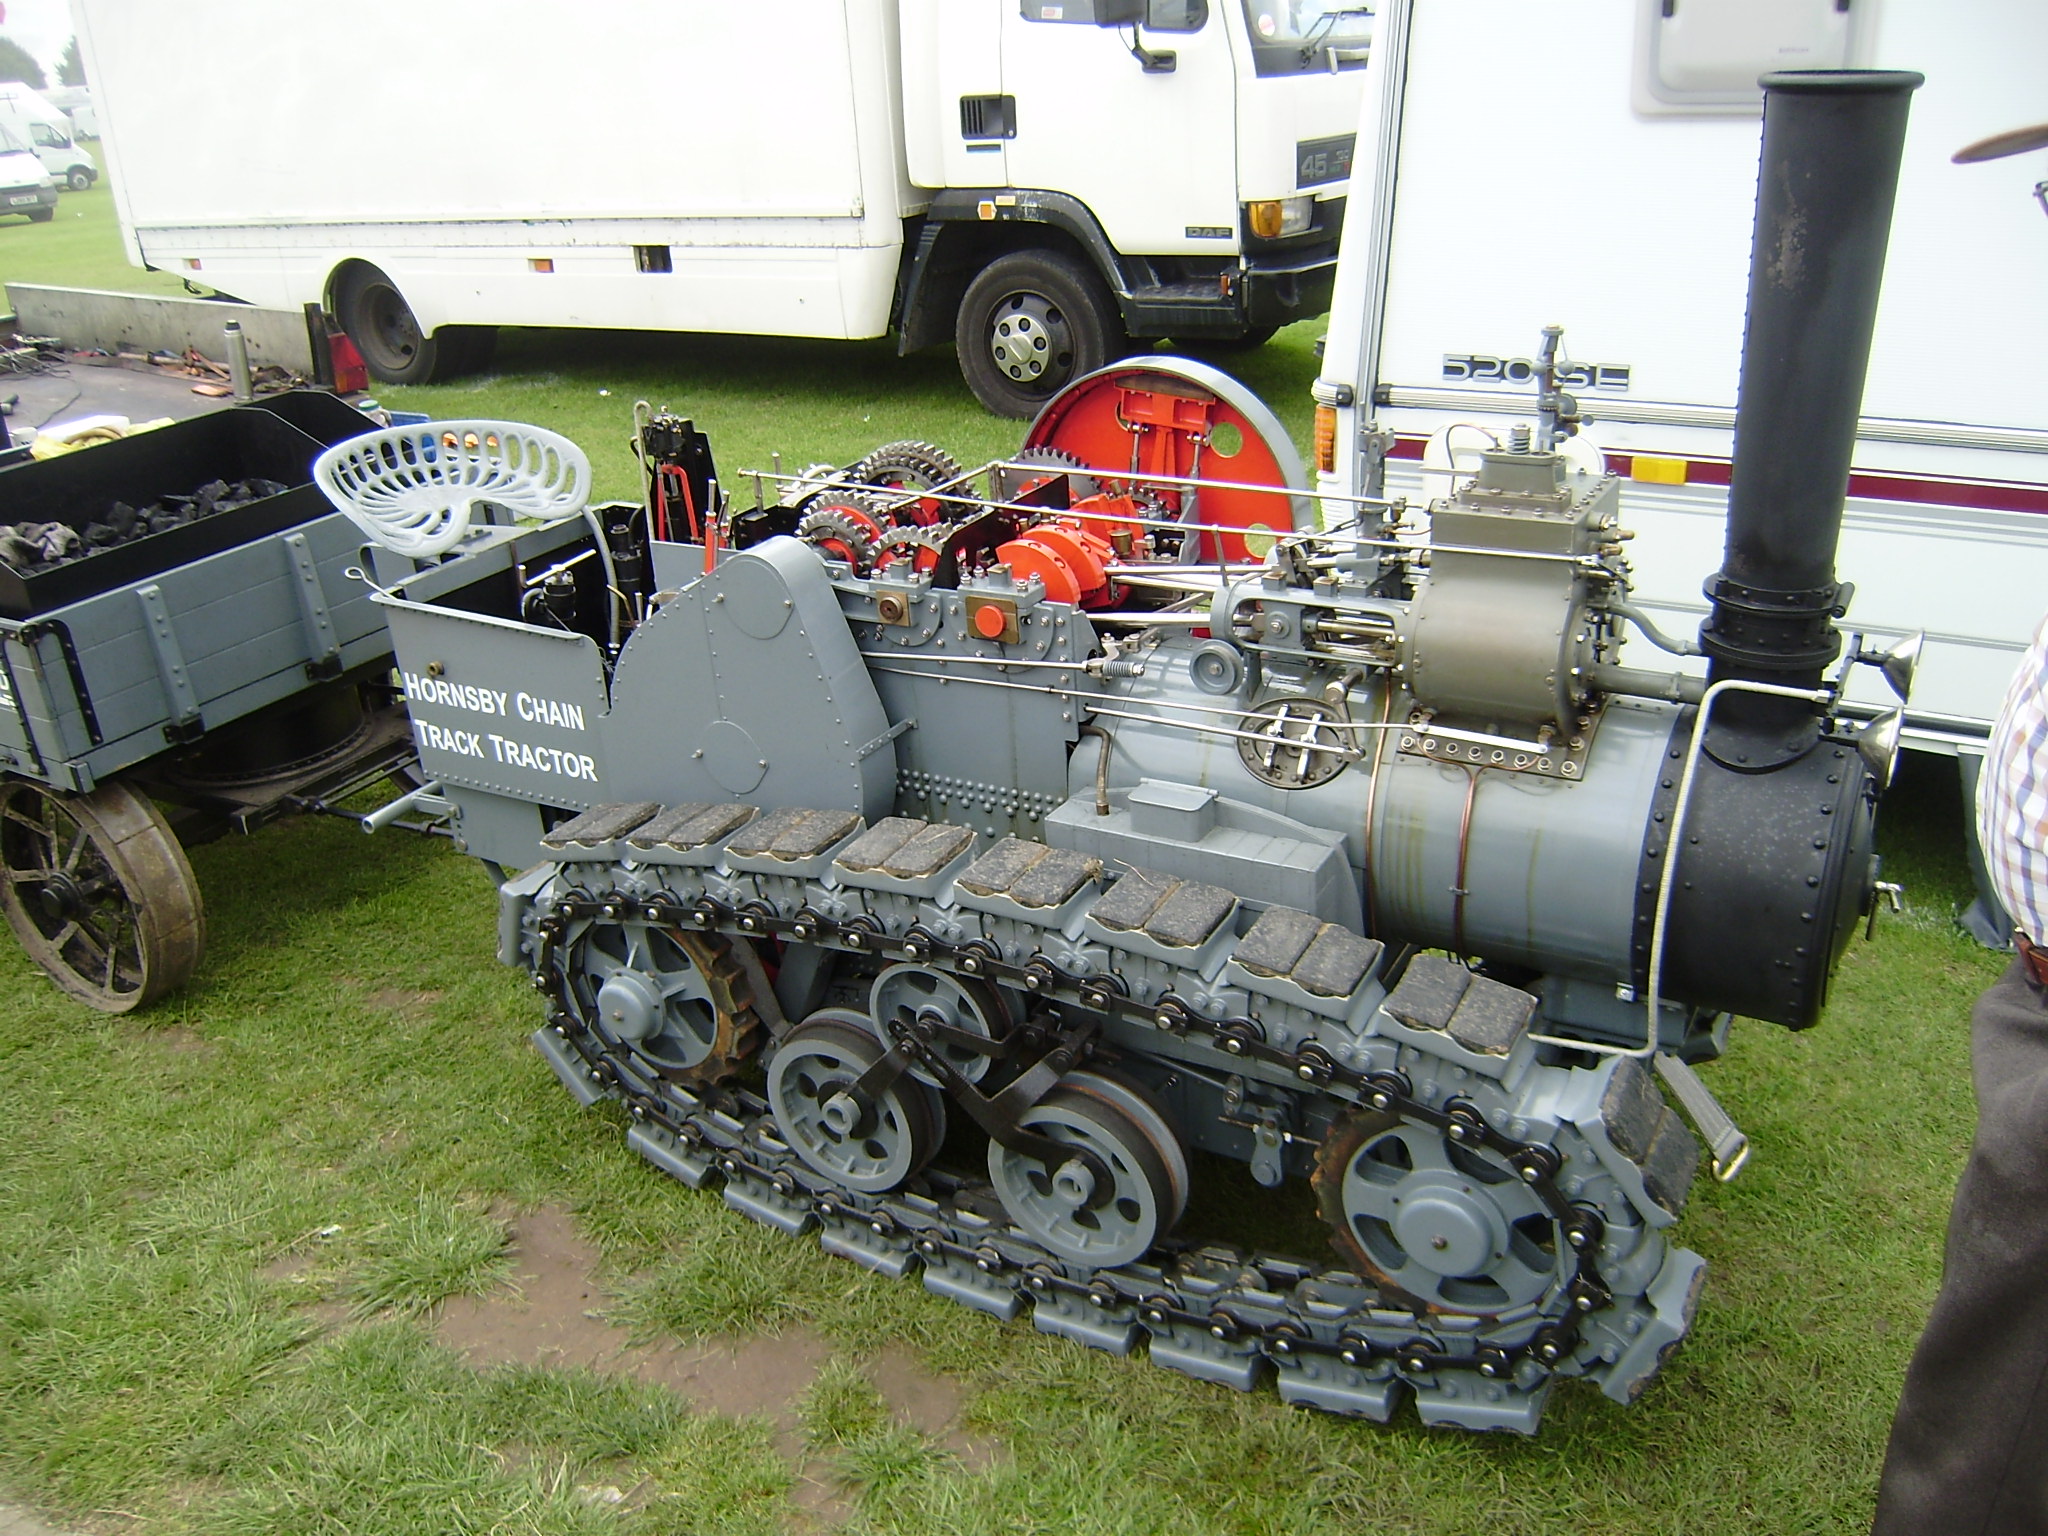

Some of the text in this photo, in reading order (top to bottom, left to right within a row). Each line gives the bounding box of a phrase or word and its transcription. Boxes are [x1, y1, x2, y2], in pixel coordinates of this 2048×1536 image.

[1301, 153, 1327, 178] 45
[1187, 227, 1230, 238] DAF
[1442, 353, 1630, 391] 520 SE
[404, 672, 585, 731] HORNSBY CHAIN
[415, 719, 598, 782] TRACK TRACTOR
